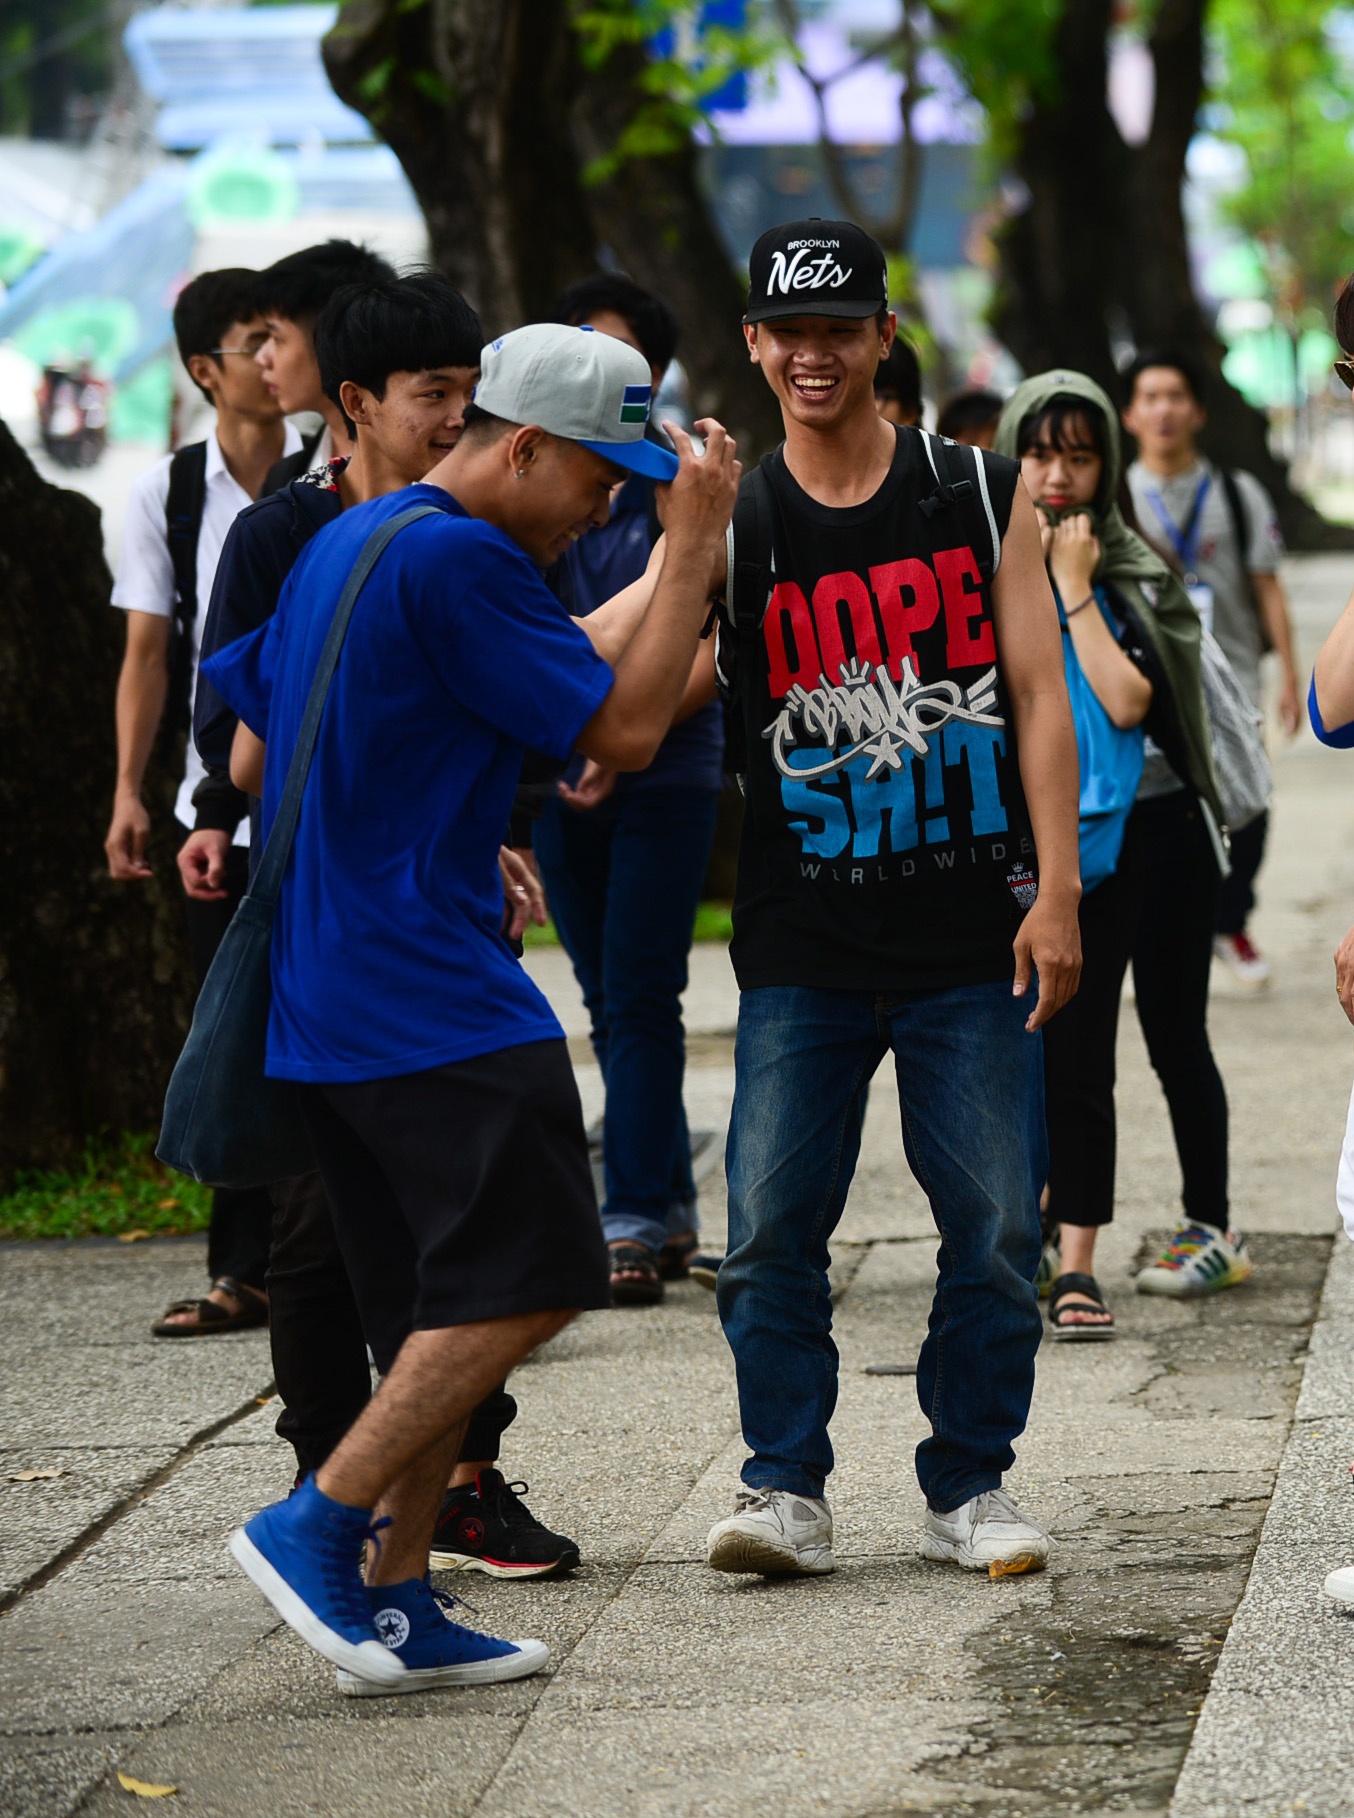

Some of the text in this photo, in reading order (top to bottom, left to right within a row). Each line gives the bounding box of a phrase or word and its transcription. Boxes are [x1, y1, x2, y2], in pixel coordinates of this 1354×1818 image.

[788, 239, 840, 250] BROOKLYN
[767, 248, 853, 296] Nets
[763, 546, 997, 699] DOPE
[1006, 871, 1034, 883] PEACE
[1010, 882, 1037, 893] UNITED
